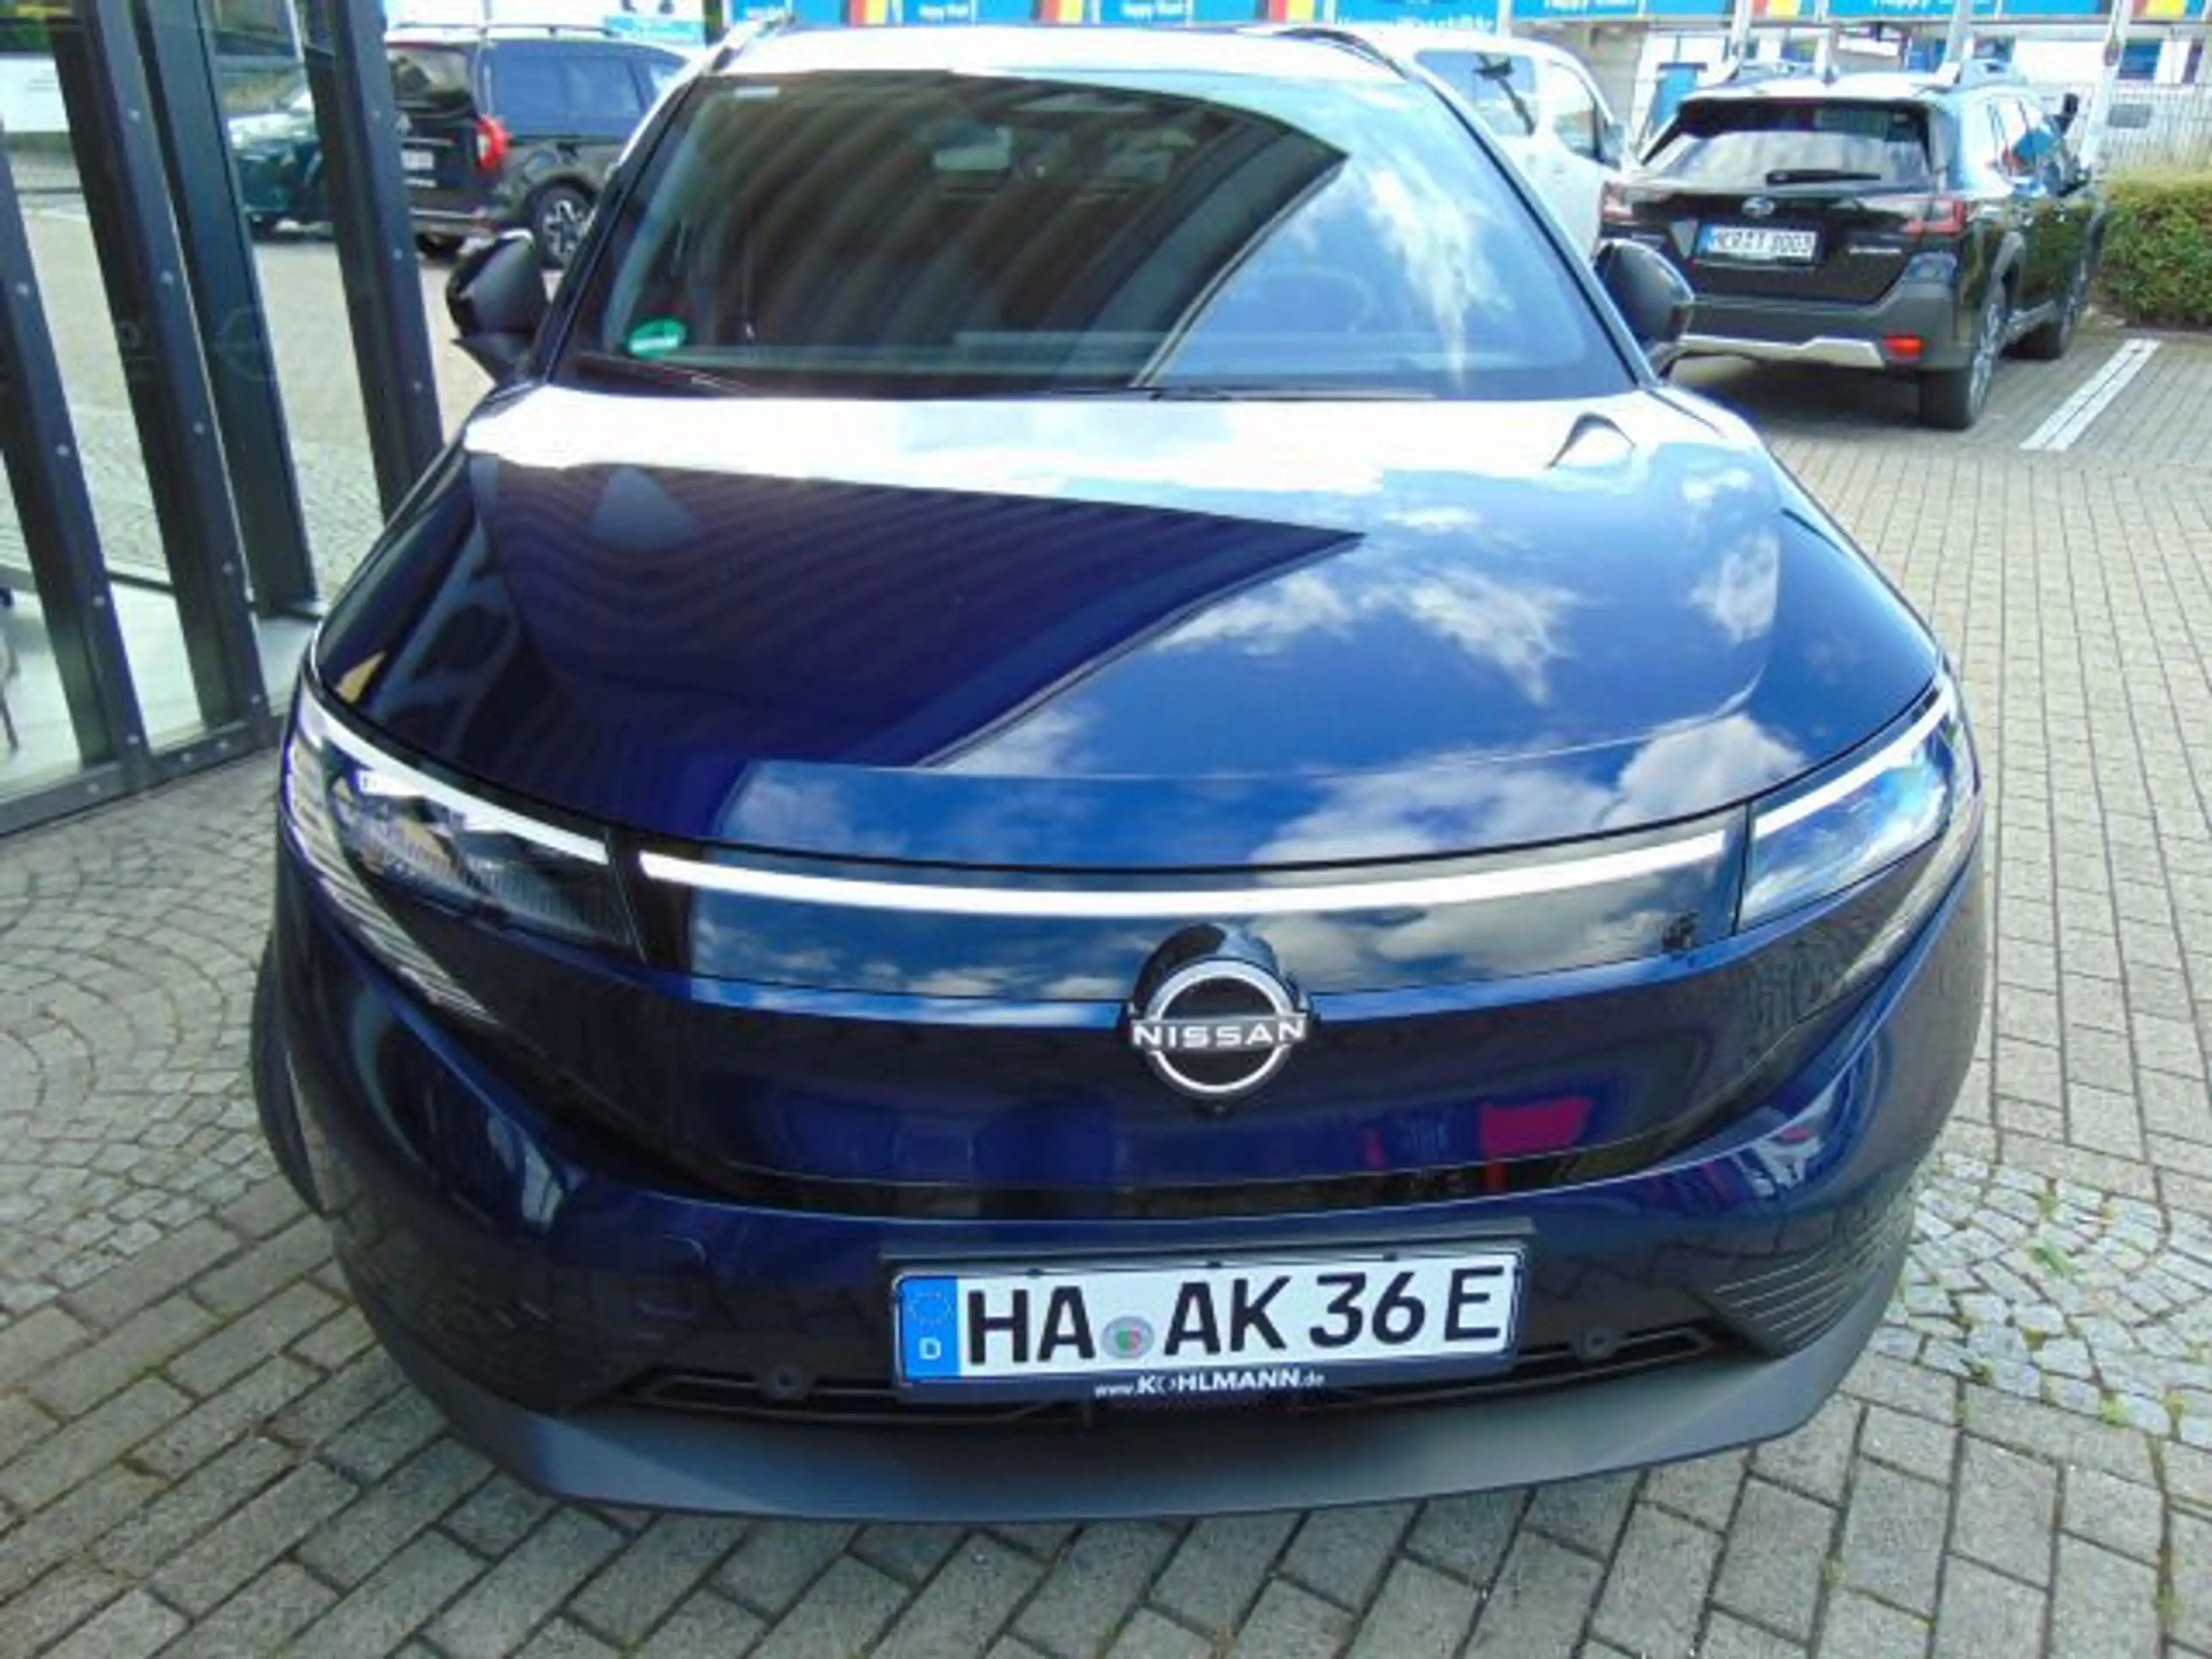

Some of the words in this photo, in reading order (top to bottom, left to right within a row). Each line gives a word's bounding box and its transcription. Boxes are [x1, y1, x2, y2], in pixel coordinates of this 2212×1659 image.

[1132, 1018, 1305, 1049] NISSAN
[968, 1286, 1096, 1365] HA
[1164, 1277, 1290, 1356] AK
[920, 1337, 941, 1360] D
